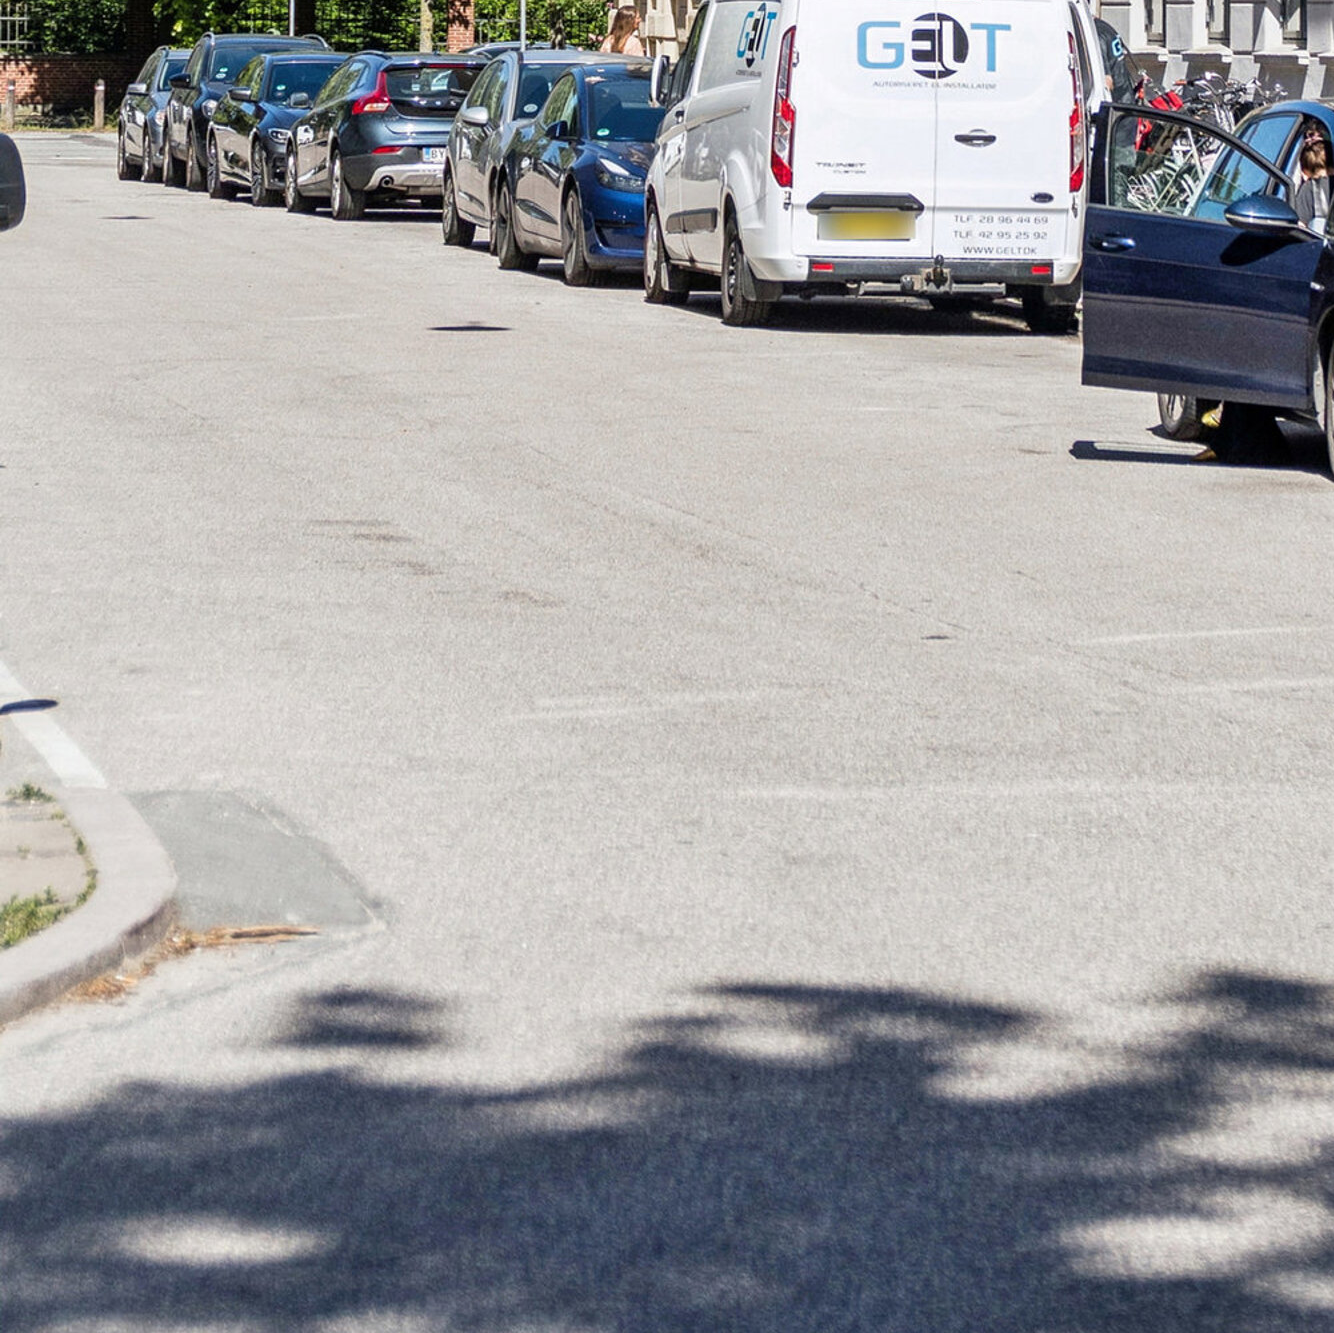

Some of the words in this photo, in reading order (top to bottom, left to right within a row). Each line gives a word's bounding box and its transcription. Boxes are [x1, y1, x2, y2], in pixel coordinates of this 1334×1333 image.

[857, 17, 1012, 75] GELT
[978, 216, 994, 225] 28
[998, 216, 1013, 225] 96
[1016, 217, 1031, 225] 44
[1033, 216, 1049, 225] 69
[979, 231, 993, 240] 42
[996, 231, 1012, 240] 95
[1015, 232, 1030, 240] 25
[1033, 232, 1048, 240] 92
